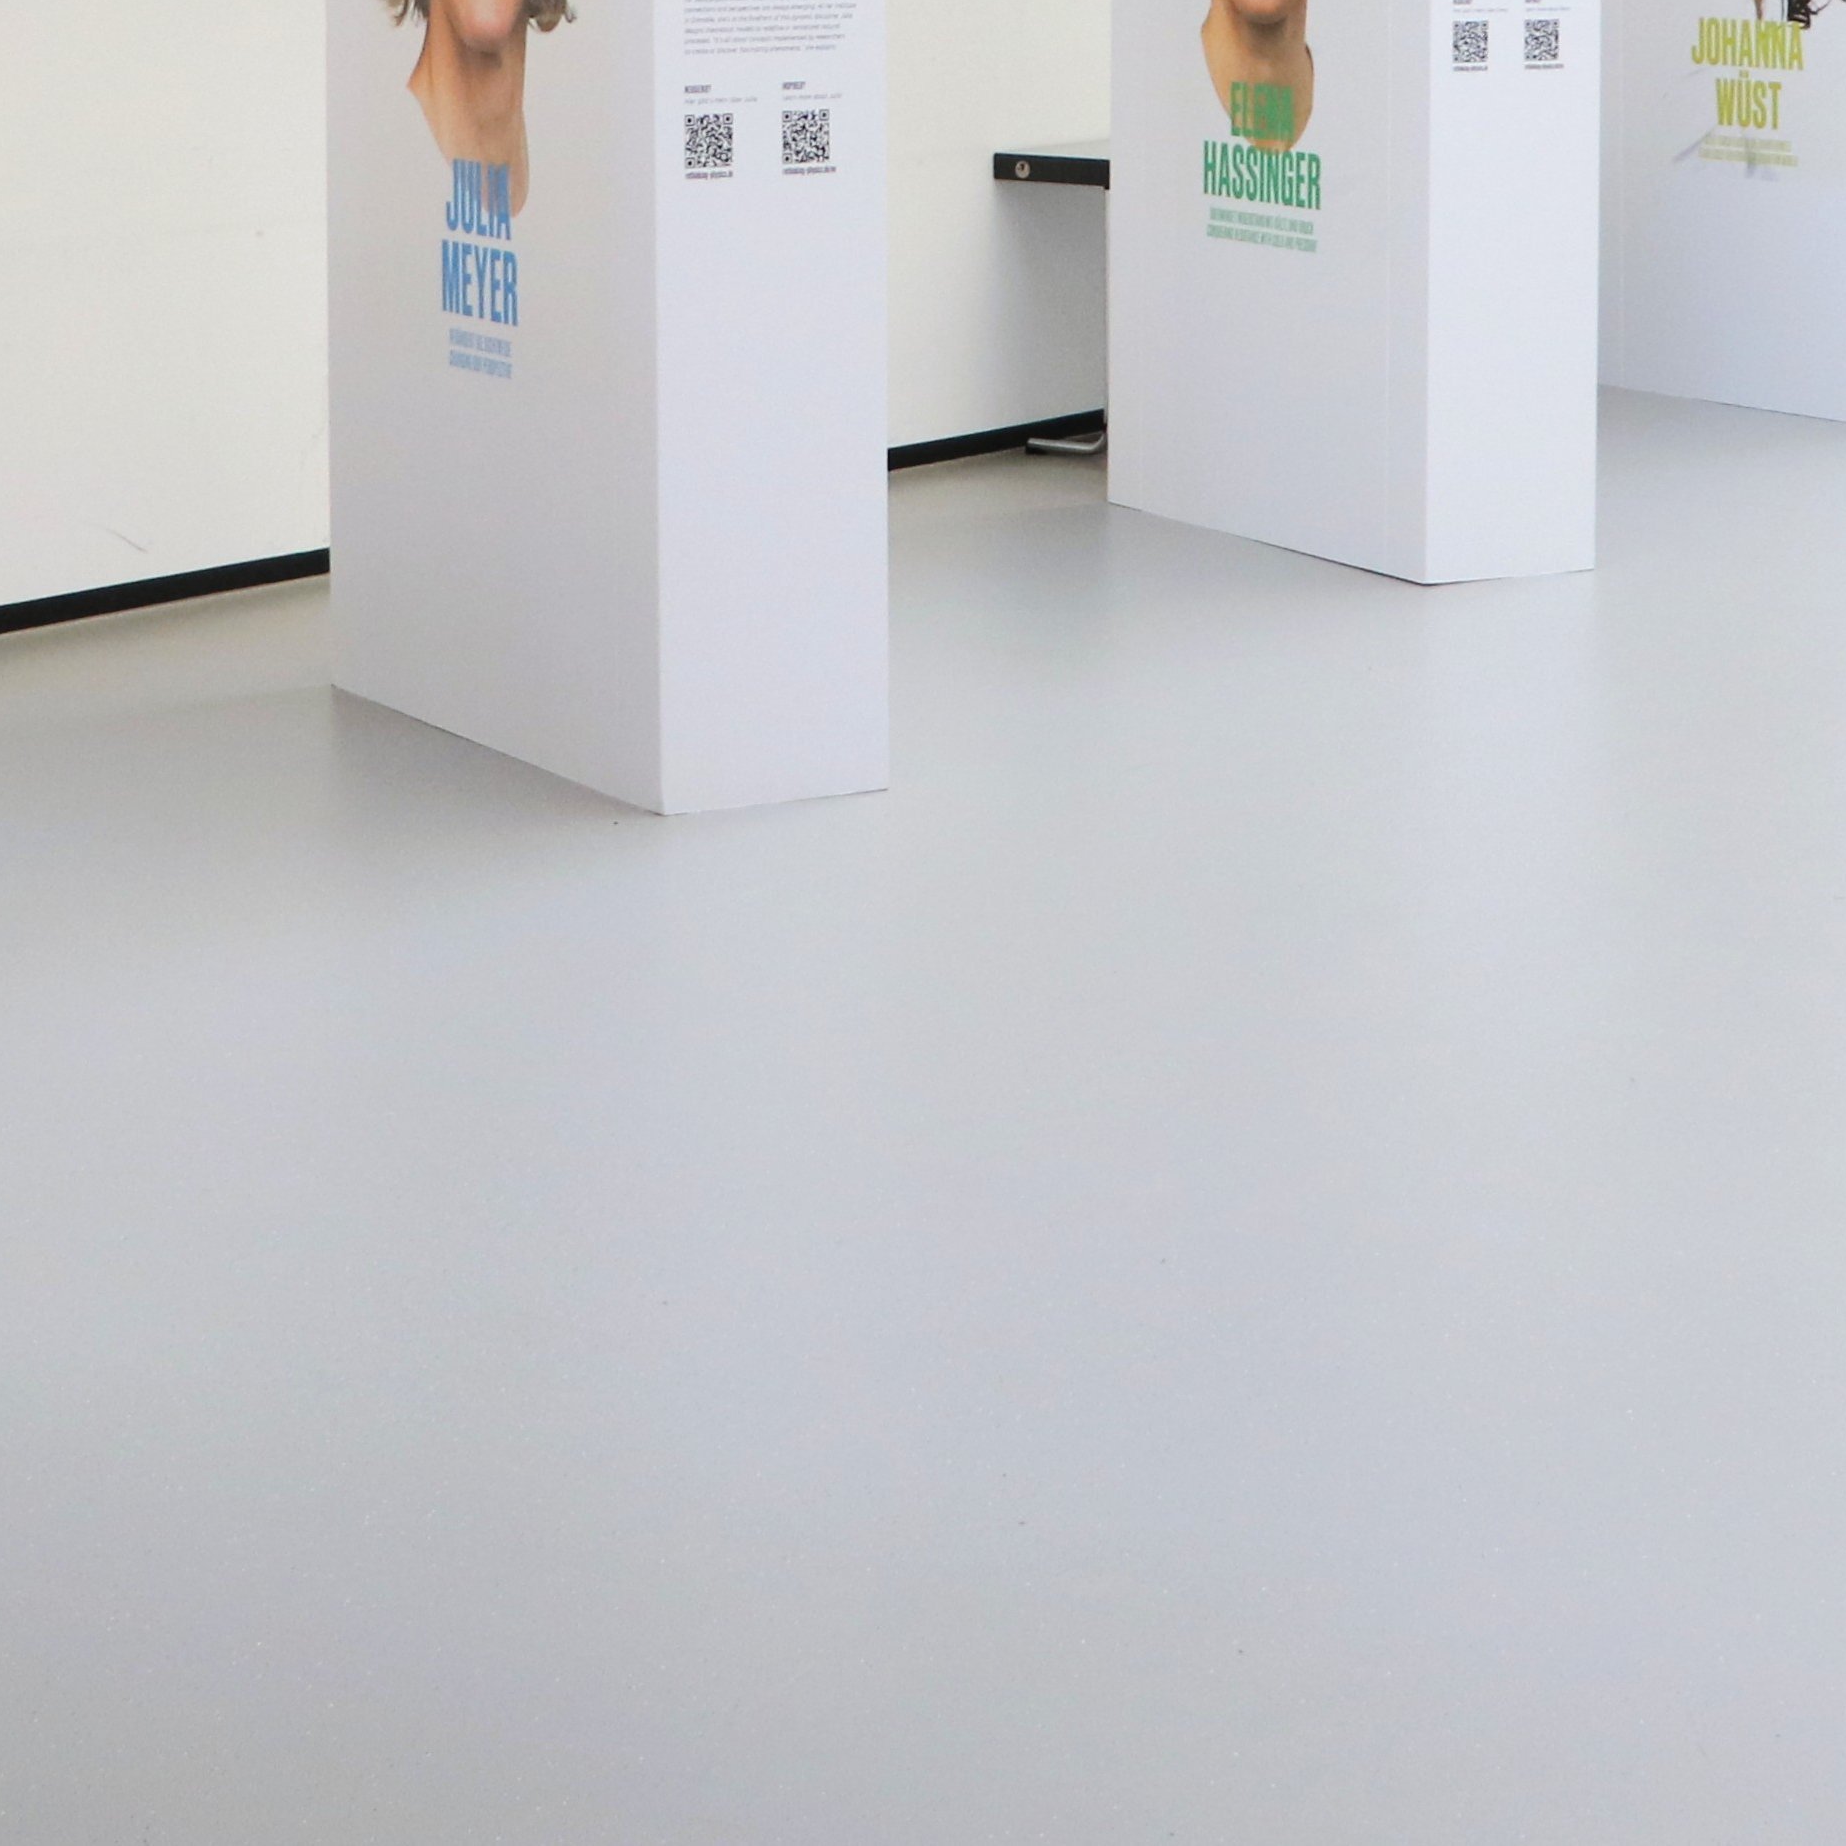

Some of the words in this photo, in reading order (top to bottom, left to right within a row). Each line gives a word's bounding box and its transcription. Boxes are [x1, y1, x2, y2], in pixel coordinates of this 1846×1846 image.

[1691, 17, 1804, 70] JOHANNA
[1716, 69, 1782, 130] WÜST
[446, 158, 511, 240] JULIA
[1203, 140, 1321, 210] HASSINGER
[441, 239, 519, 326] MEYER
